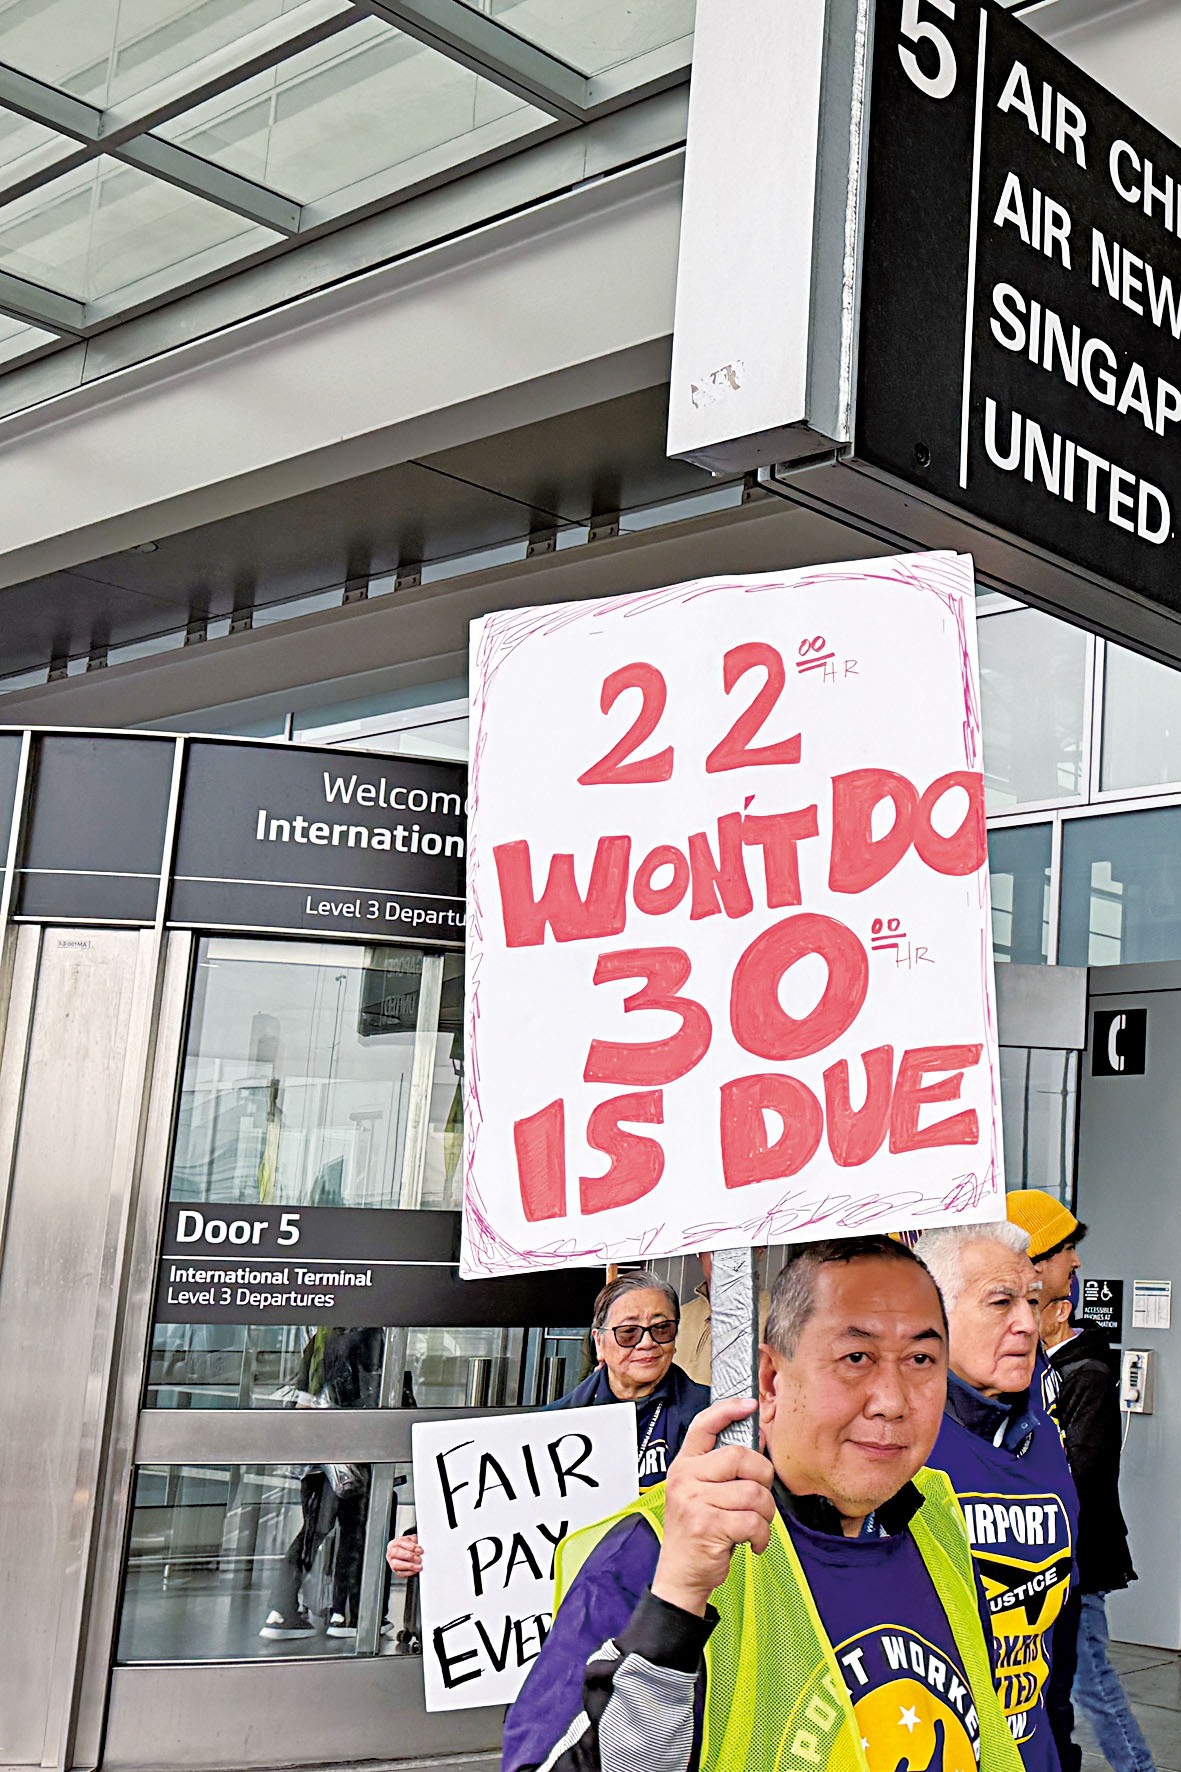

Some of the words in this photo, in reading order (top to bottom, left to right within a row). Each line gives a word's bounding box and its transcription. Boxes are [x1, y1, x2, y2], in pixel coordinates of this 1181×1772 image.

[898, 0, 957, 99] 5
[997, 60, 1087, 170] AIR
[993, 171, 1072, 270] AIR
[985, 396, 1172, 546] UNITED
[823, 658, 860, 684] HR
[323, 771, 469, 818] Welcom
[255, 809, 465, 858] Internation
[493, 794, 819, 948] WON'T
[829, 768, 986, 894] DO
[305, 895, 361, 919] Level
[366, 900, 380, 919] 3
[385, 902, 466, 926] Departu
[583, 912, 870, 1086] 30
[895, 940, 935, 970] HR
[513, 1089, 666, 1222] IS
[719, 1042, 984, 1189] DUE
[176, 1210, 269, 1244] Door
[276, 1213, 301, 1246] 5
[167, 1287, 215, 1305] Level
[219, 1288, 232, 1305] 3
[236, 1288, 335, 1309] Departures
[169, 1265, 290, 1284] International
[295, 1268, 373, 1286] Terminal
[436, 1433, 600, 1530] FAIR
[964, 1503, 1059, 1546] IRPORT
[466, 1520, 569, 1597] PAY
[989, 1566, 1059, 1613] USTICE
